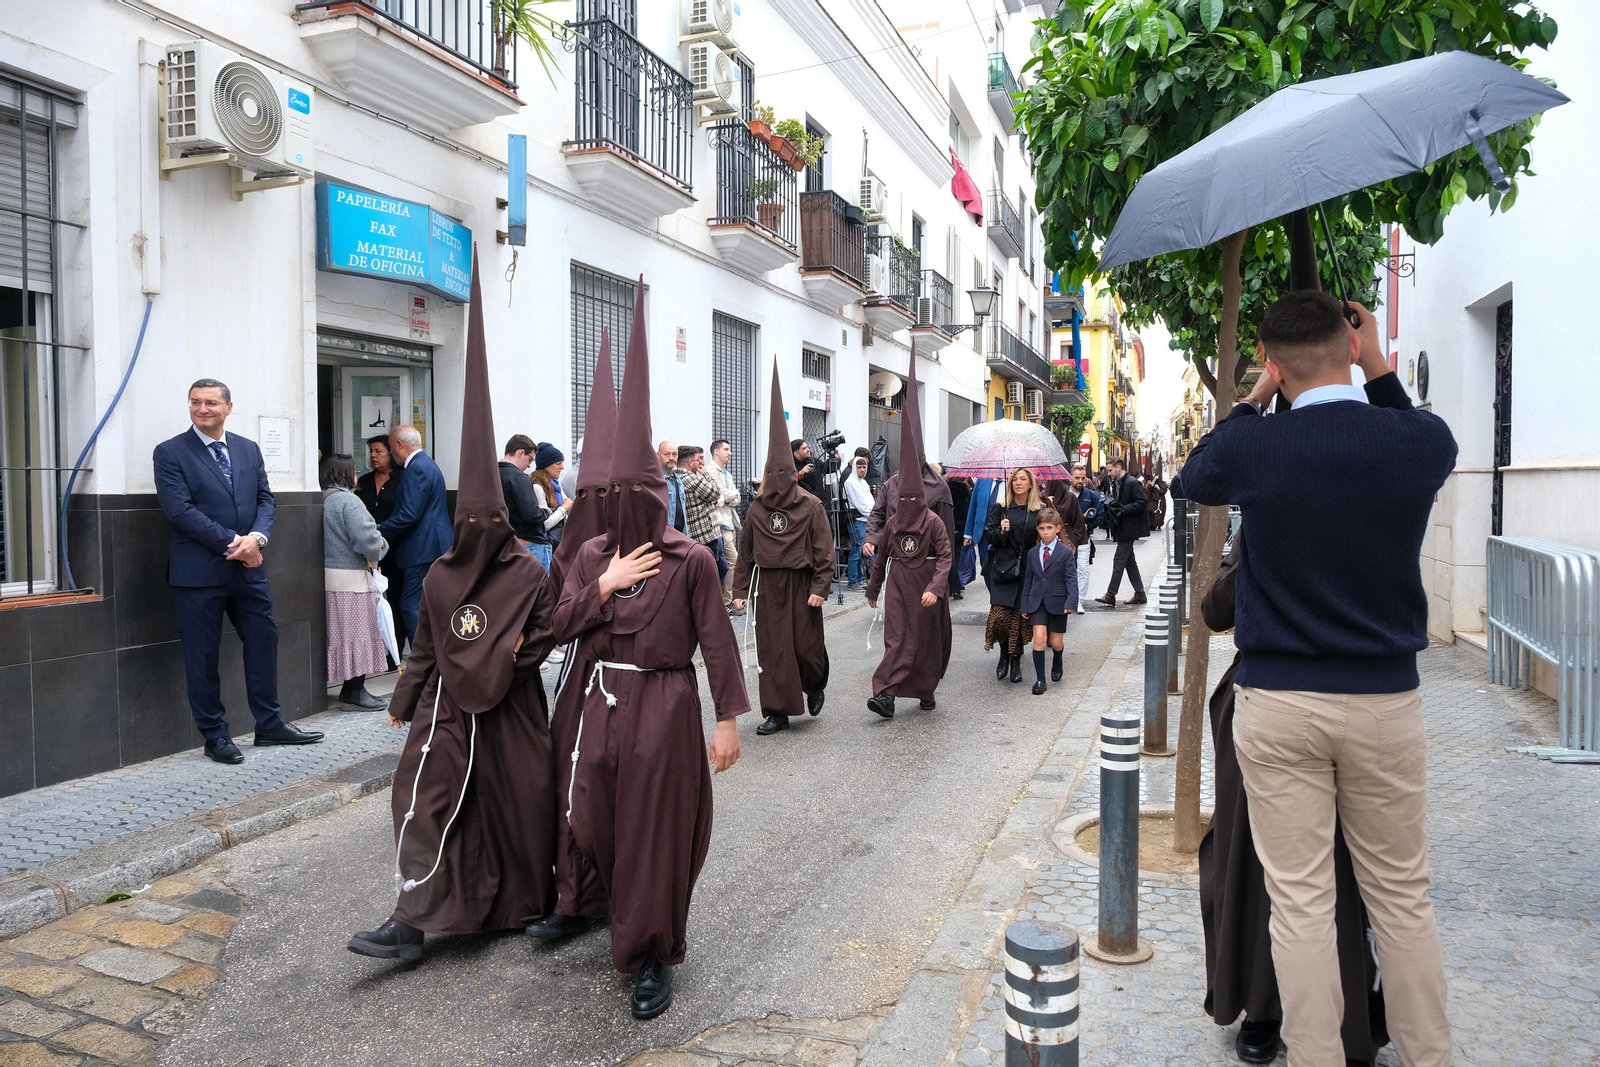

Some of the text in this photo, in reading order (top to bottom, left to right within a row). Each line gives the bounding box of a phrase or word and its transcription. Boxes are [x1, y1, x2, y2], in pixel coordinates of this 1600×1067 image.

[336, 190, 410, 217] PAPELERÍA
[369, 221, 397, 237] FAX
[431, 212, 454, 232] LIBROS
[431, 226, 462, 251] DE TEXTO
[356, 240, 425, 264] MATERIAL
[449, 251, 455, 262] &
[349, 254, 425, 278] DE OFICINA
[441, 261, 470, 285] MATERIAL
[444, 277, 470, 297] ESCOLAR
